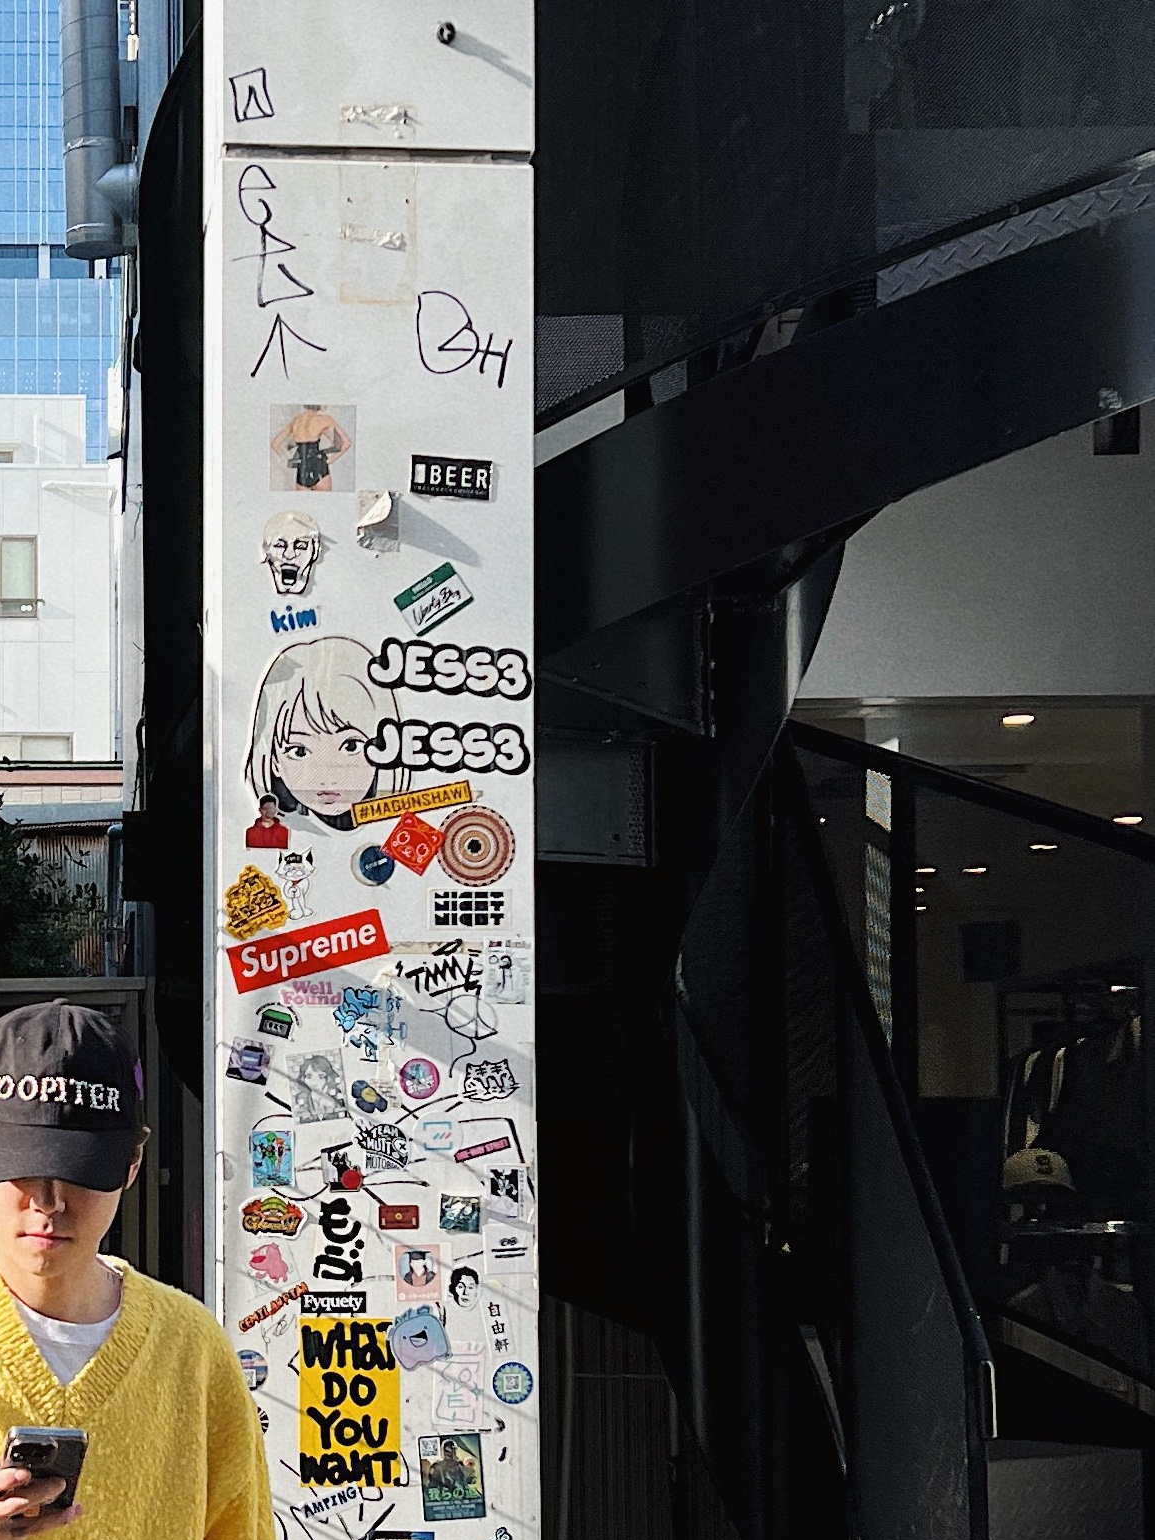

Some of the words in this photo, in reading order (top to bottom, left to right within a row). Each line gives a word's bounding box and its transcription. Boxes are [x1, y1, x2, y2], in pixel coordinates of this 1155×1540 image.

[429, 464, 488, 490] BEER
[270, 605, 317, 633] kim
[368, 639, 532, 700] JESS3
[364, 718, 531, 775] JESS3
[240, 922, 378, 979] Supreme
[281, 988, 343, 1005] Found
[292, 980, 333, 994] Well
[303, 1294, 364, 1312] Fyquety
[321, 1371, 377, 1408] DO
[306, 1406, 389, 1450] YOU
[304, 1486, 357, 1519] AMPING
